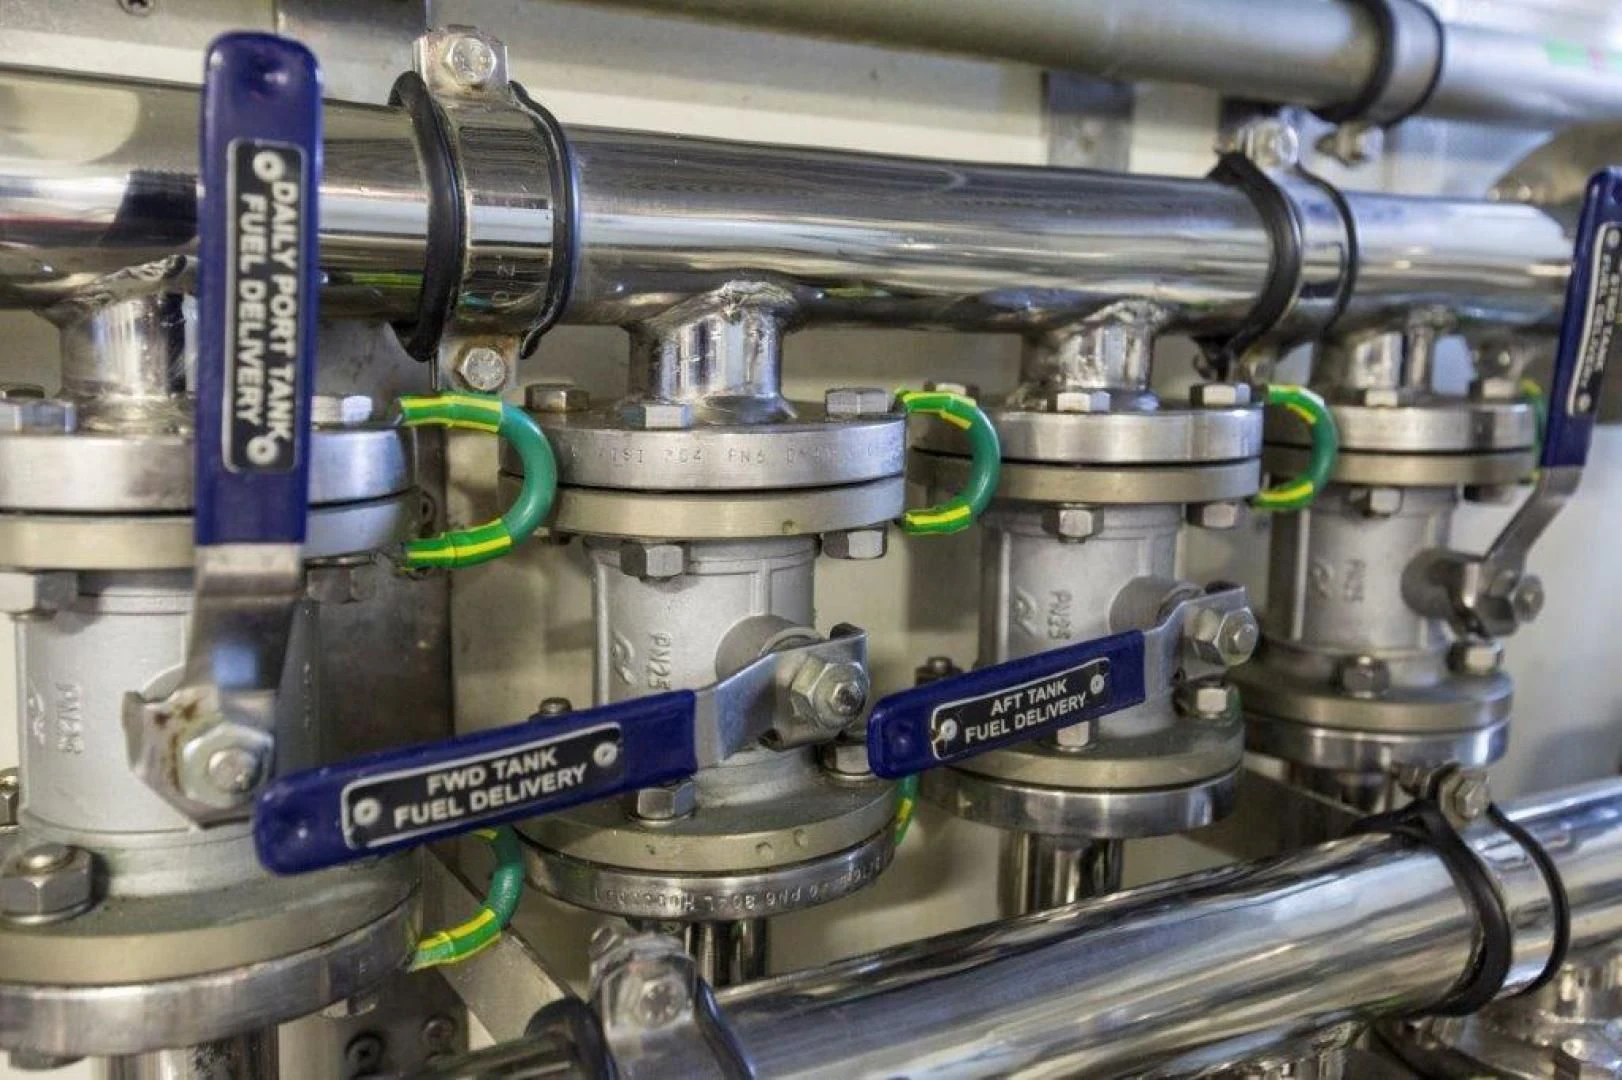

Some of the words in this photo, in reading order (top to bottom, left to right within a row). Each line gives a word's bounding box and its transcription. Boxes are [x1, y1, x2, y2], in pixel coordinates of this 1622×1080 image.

[240, 193, 267, 273] FUEL
[271, 181, 298, 270] DAILY
[236, 279, 267, 426] DELIVERY
[269, 274, 297, 358] PORT
[266, 364, 295, 441] TANK
[965, 716, 1010, 744] FUEL
[1014, 691, 1087, 729] DELIVERY
[990, 692, 1024, 717] AFT
[1027, 678, 1068, 704] TANK
[393, 797, 465, 829] FUEL
[469, 763, 587, 812] DELIVERY
[426, 766, 486, 796] FWD
[491, 747, 558, 779] TANK
